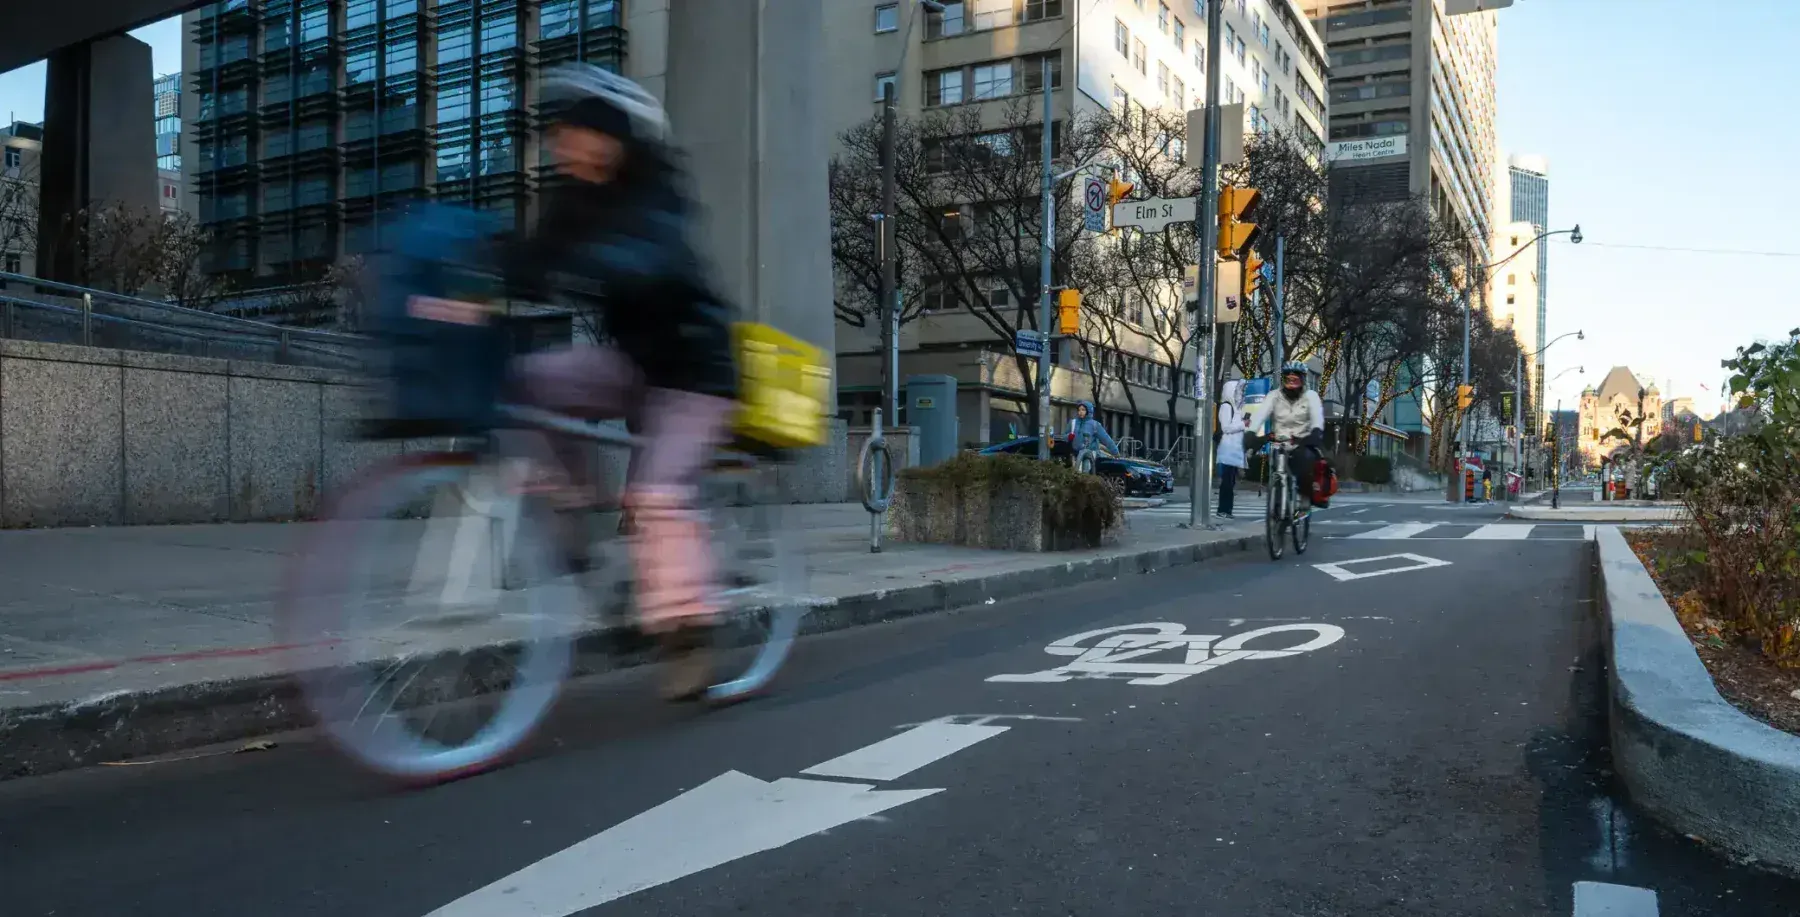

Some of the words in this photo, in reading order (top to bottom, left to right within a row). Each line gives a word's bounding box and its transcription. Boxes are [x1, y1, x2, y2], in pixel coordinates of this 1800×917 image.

[1339, 143, 1363, 152] Miles
[1365, 138, 1395, 149] Nadal
[1373, 149, 1394, 157] Centre
[1136, 206, 1157, 219] Elm
[1162, 204, 1173, 217] St
